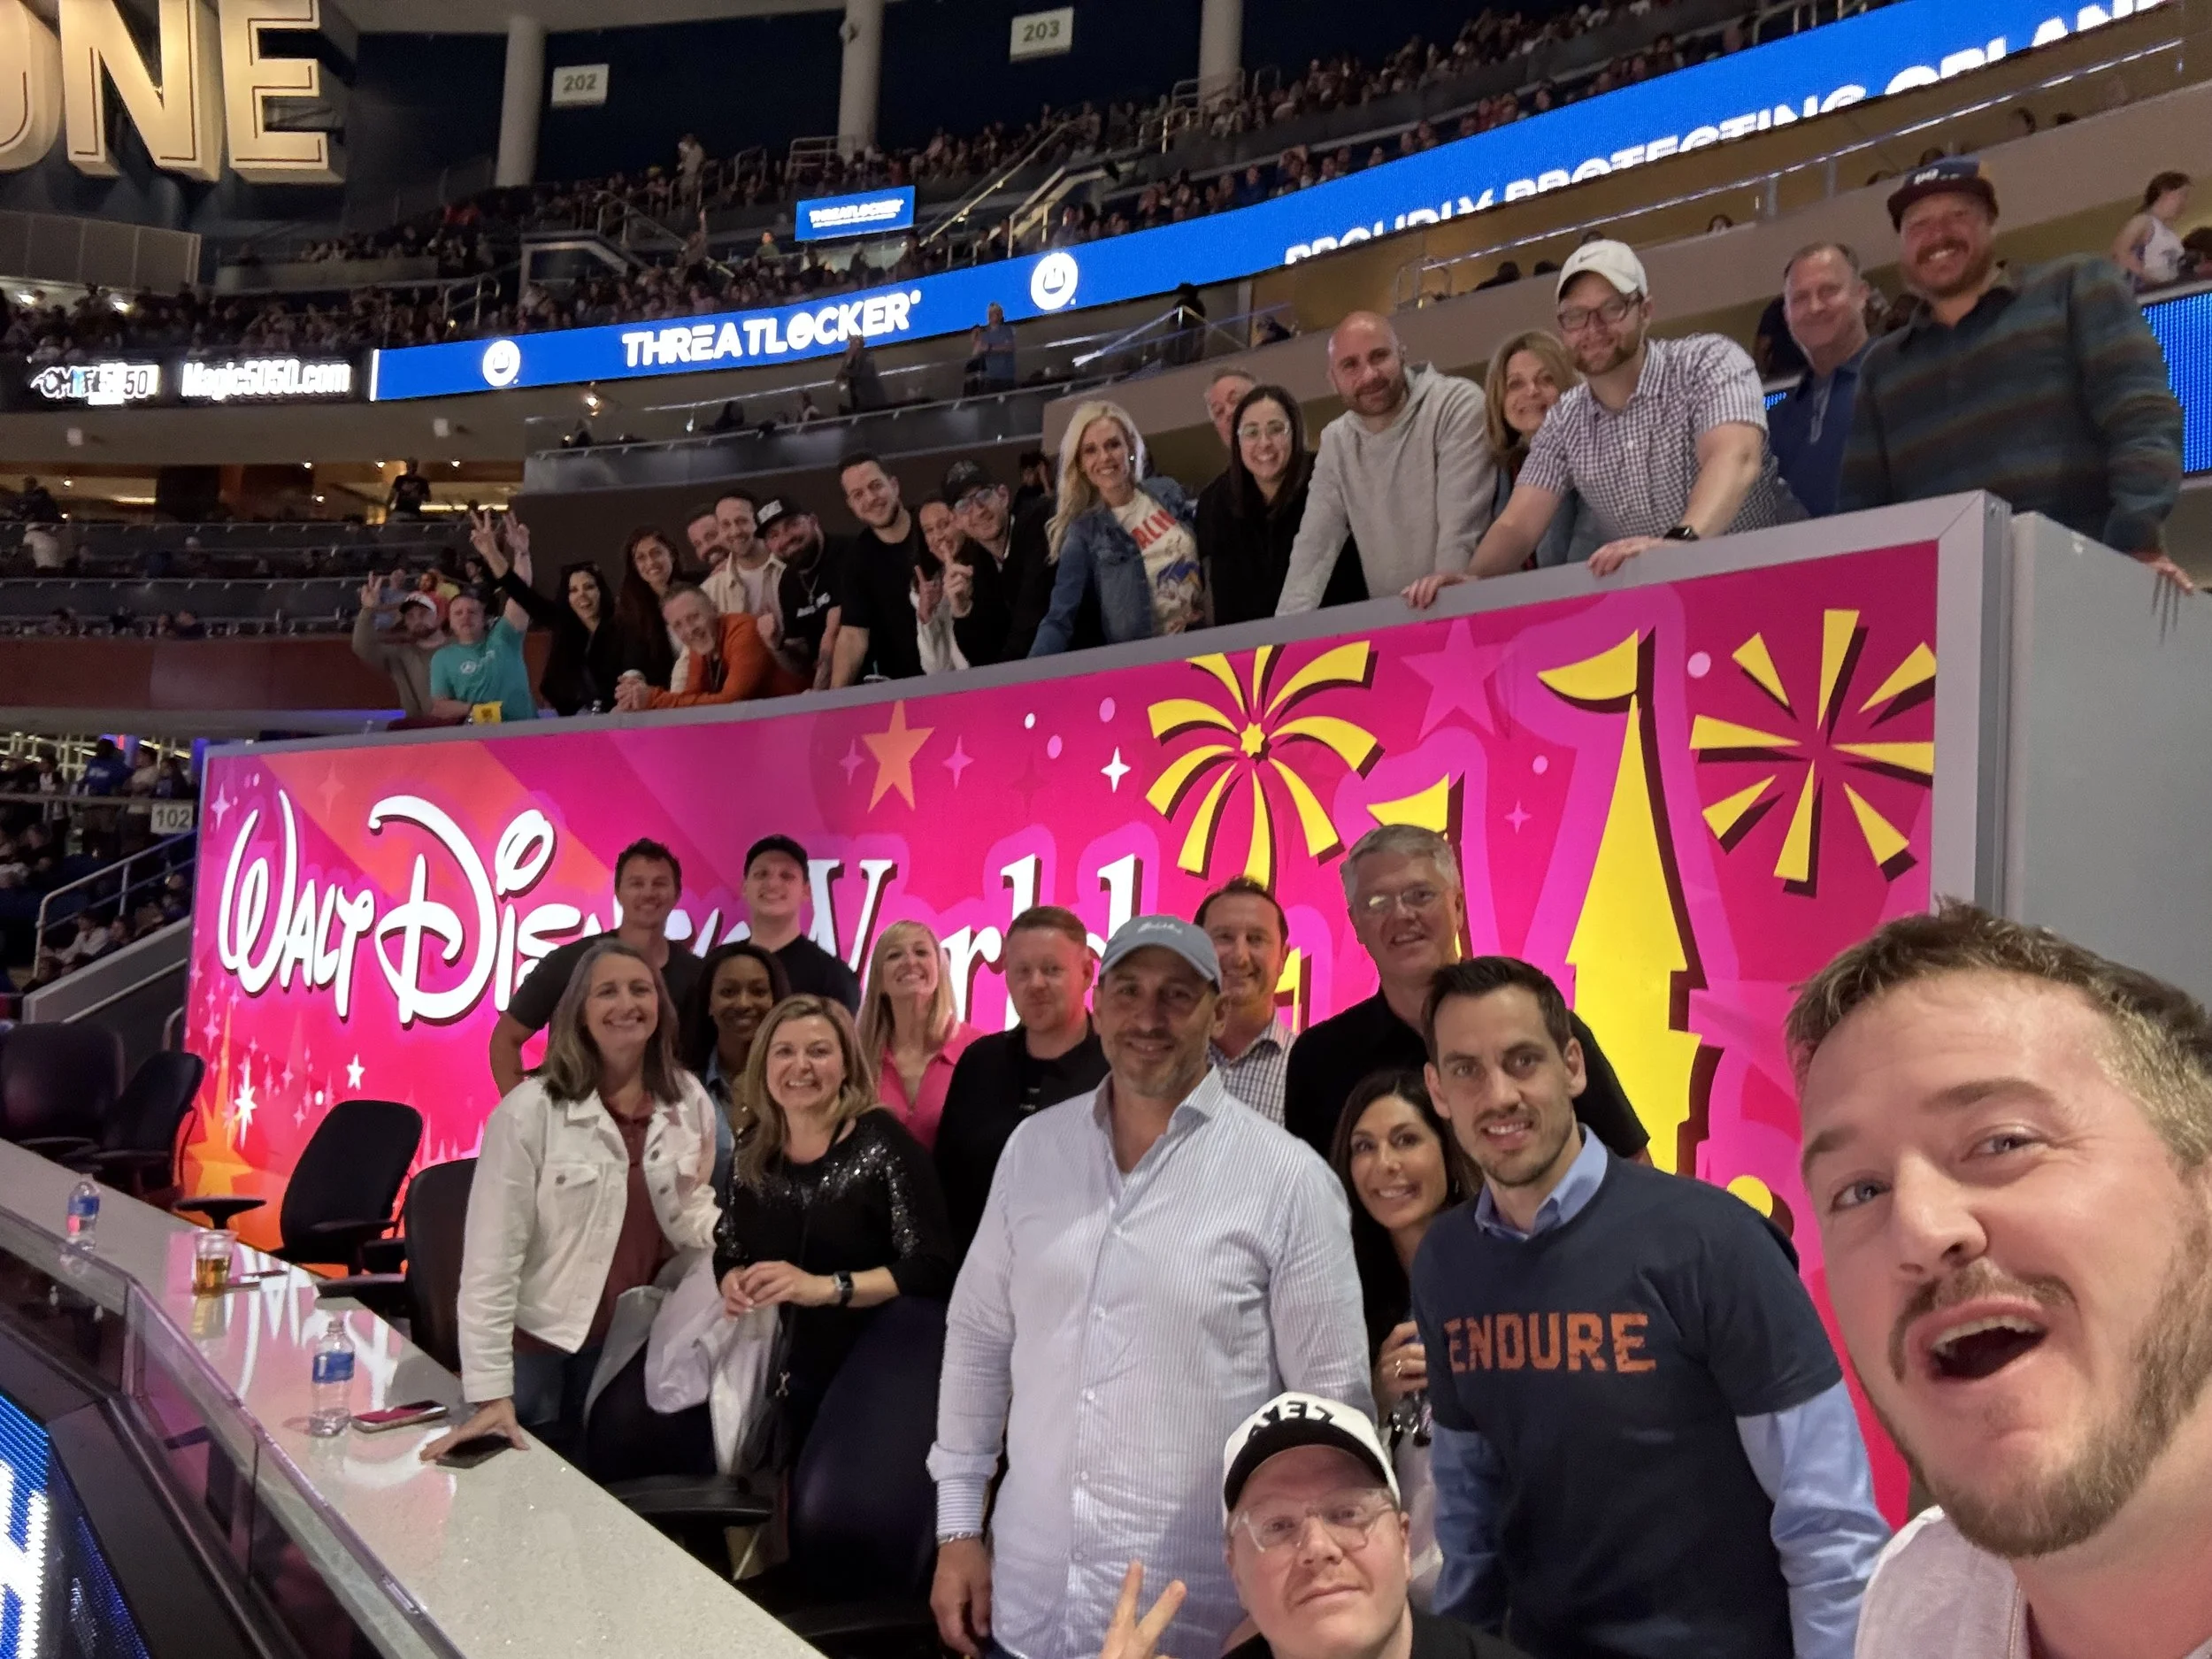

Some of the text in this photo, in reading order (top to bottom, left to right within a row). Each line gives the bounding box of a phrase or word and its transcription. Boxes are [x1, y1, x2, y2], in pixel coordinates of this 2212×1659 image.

[1024, 19, 1060, 42] 203
[0, 0, 329, 170] NE
[563, 73, 597, 94] 202
[622, 293, 910, 350] THREATLOCKER
[180, 358, 351, 400] Magic5050.com
[157, 807, 191, 829] 102
[1443, 1312, 1656, 1372] ENDURE
